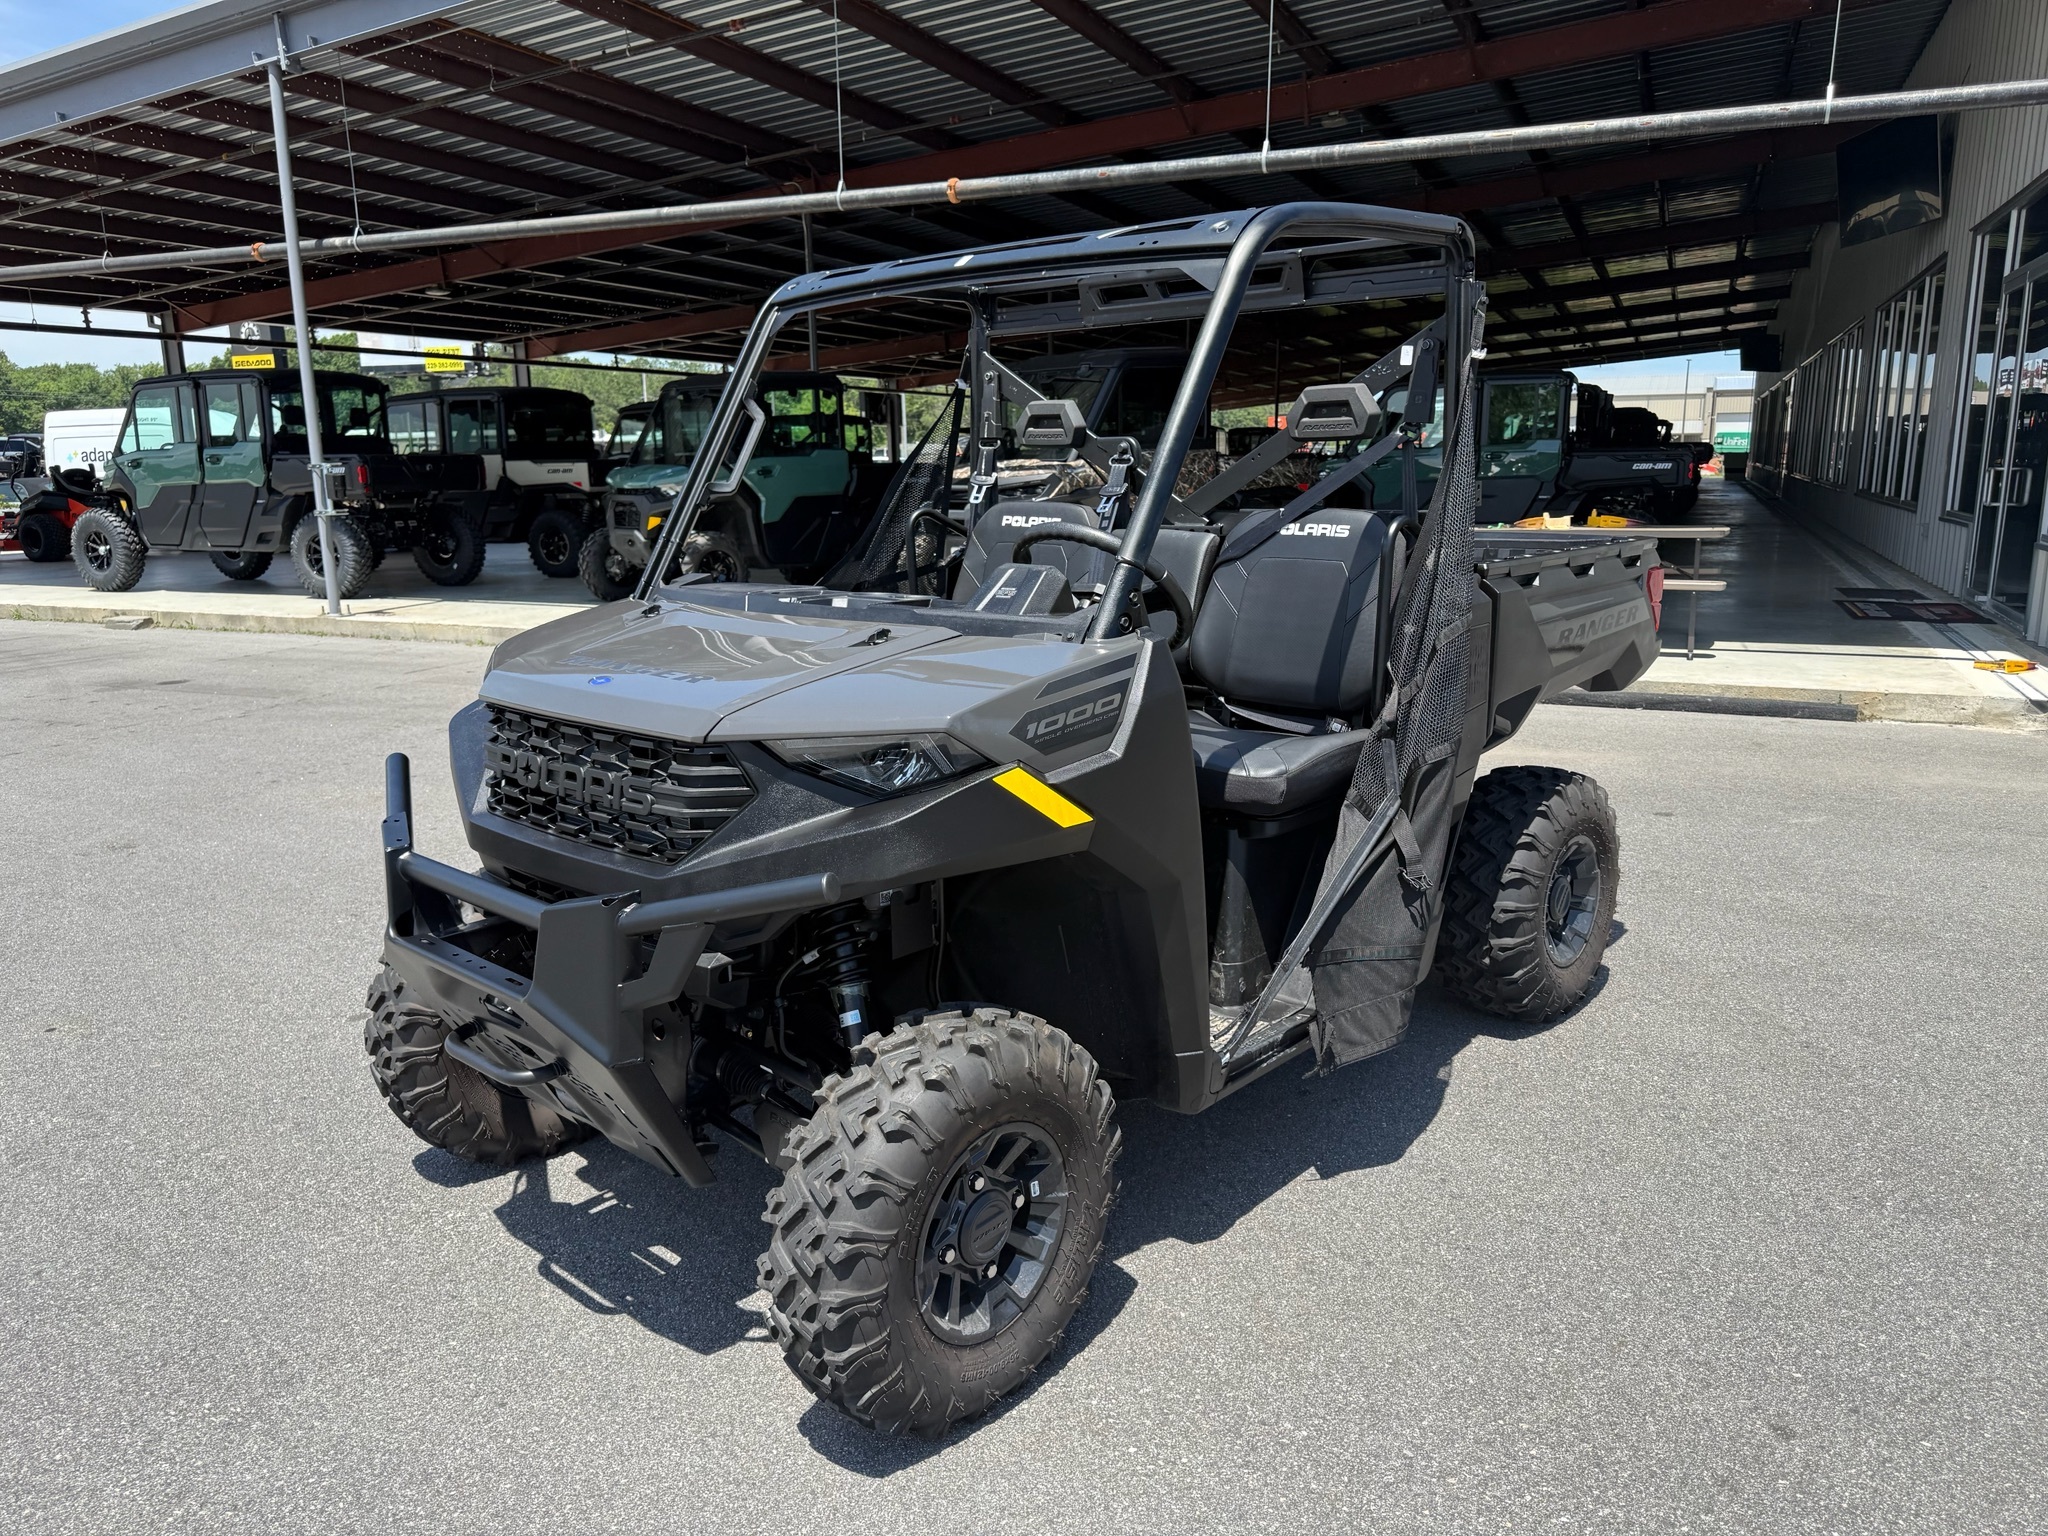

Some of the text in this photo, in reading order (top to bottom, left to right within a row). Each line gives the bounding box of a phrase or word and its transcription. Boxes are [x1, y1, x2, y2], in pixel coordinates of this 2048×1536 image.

[1302, 422, 1354, 432] RANGER
[81, 447, 113, 463] adap
[1280, 522, 1351, 538] OLARIS
[1558, 604, 1640, 644] RANGER
[1025, 692, 1122, 740] 1000
[495, 744, 656, 816] POLARIS
